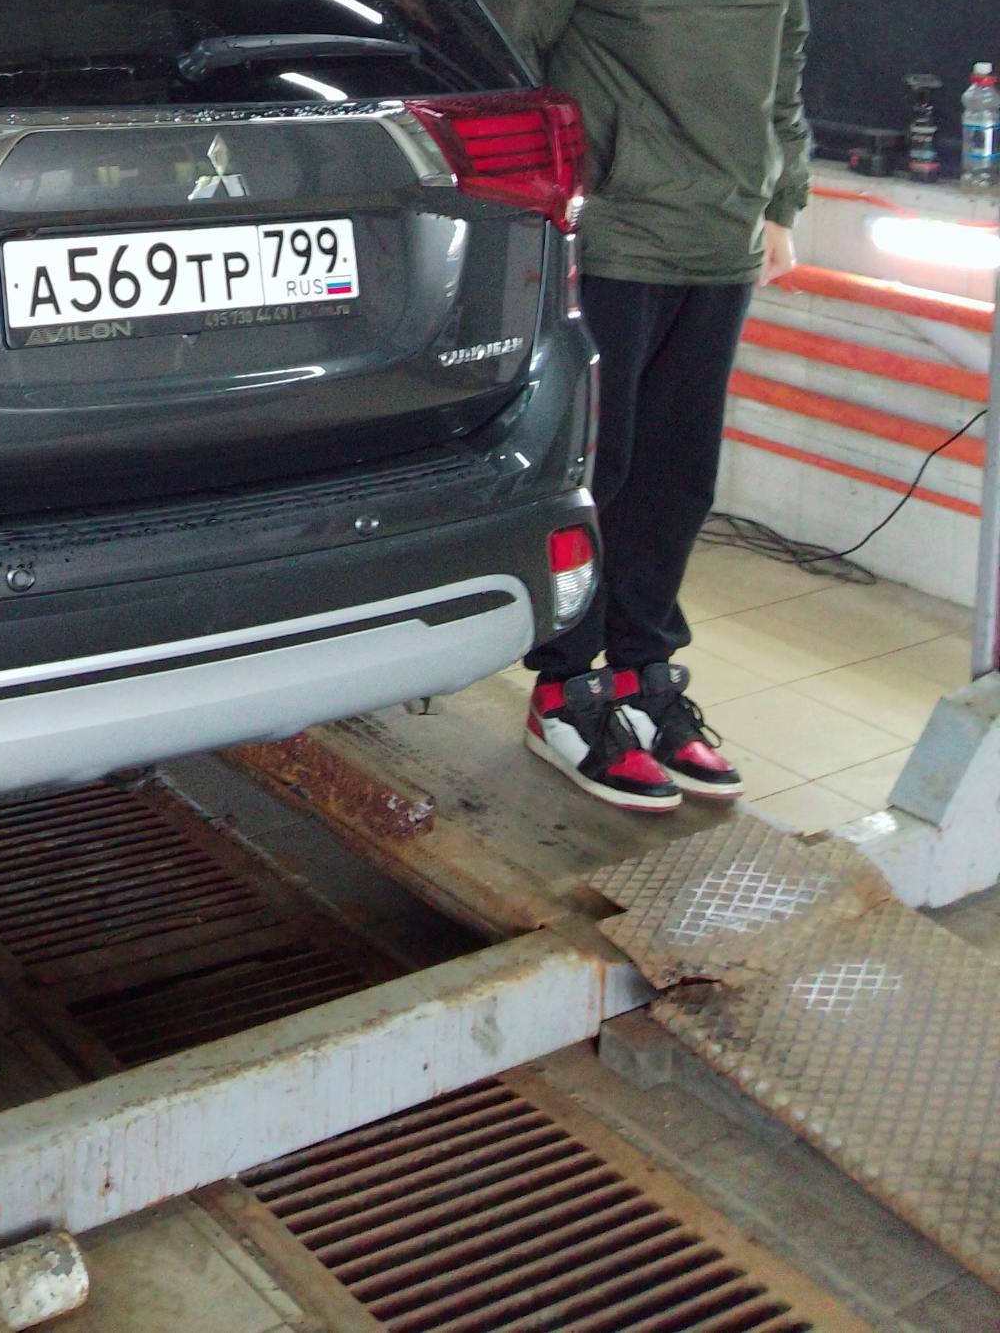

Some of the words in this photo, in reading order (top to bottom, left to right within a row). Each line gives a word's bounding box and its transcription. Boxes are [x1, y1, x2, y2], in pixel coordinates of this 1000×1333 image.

[263, 227, 338, 277] 799
[286, 278, 324, 297] RUS
[24, 320, 132, 346] AVILON
